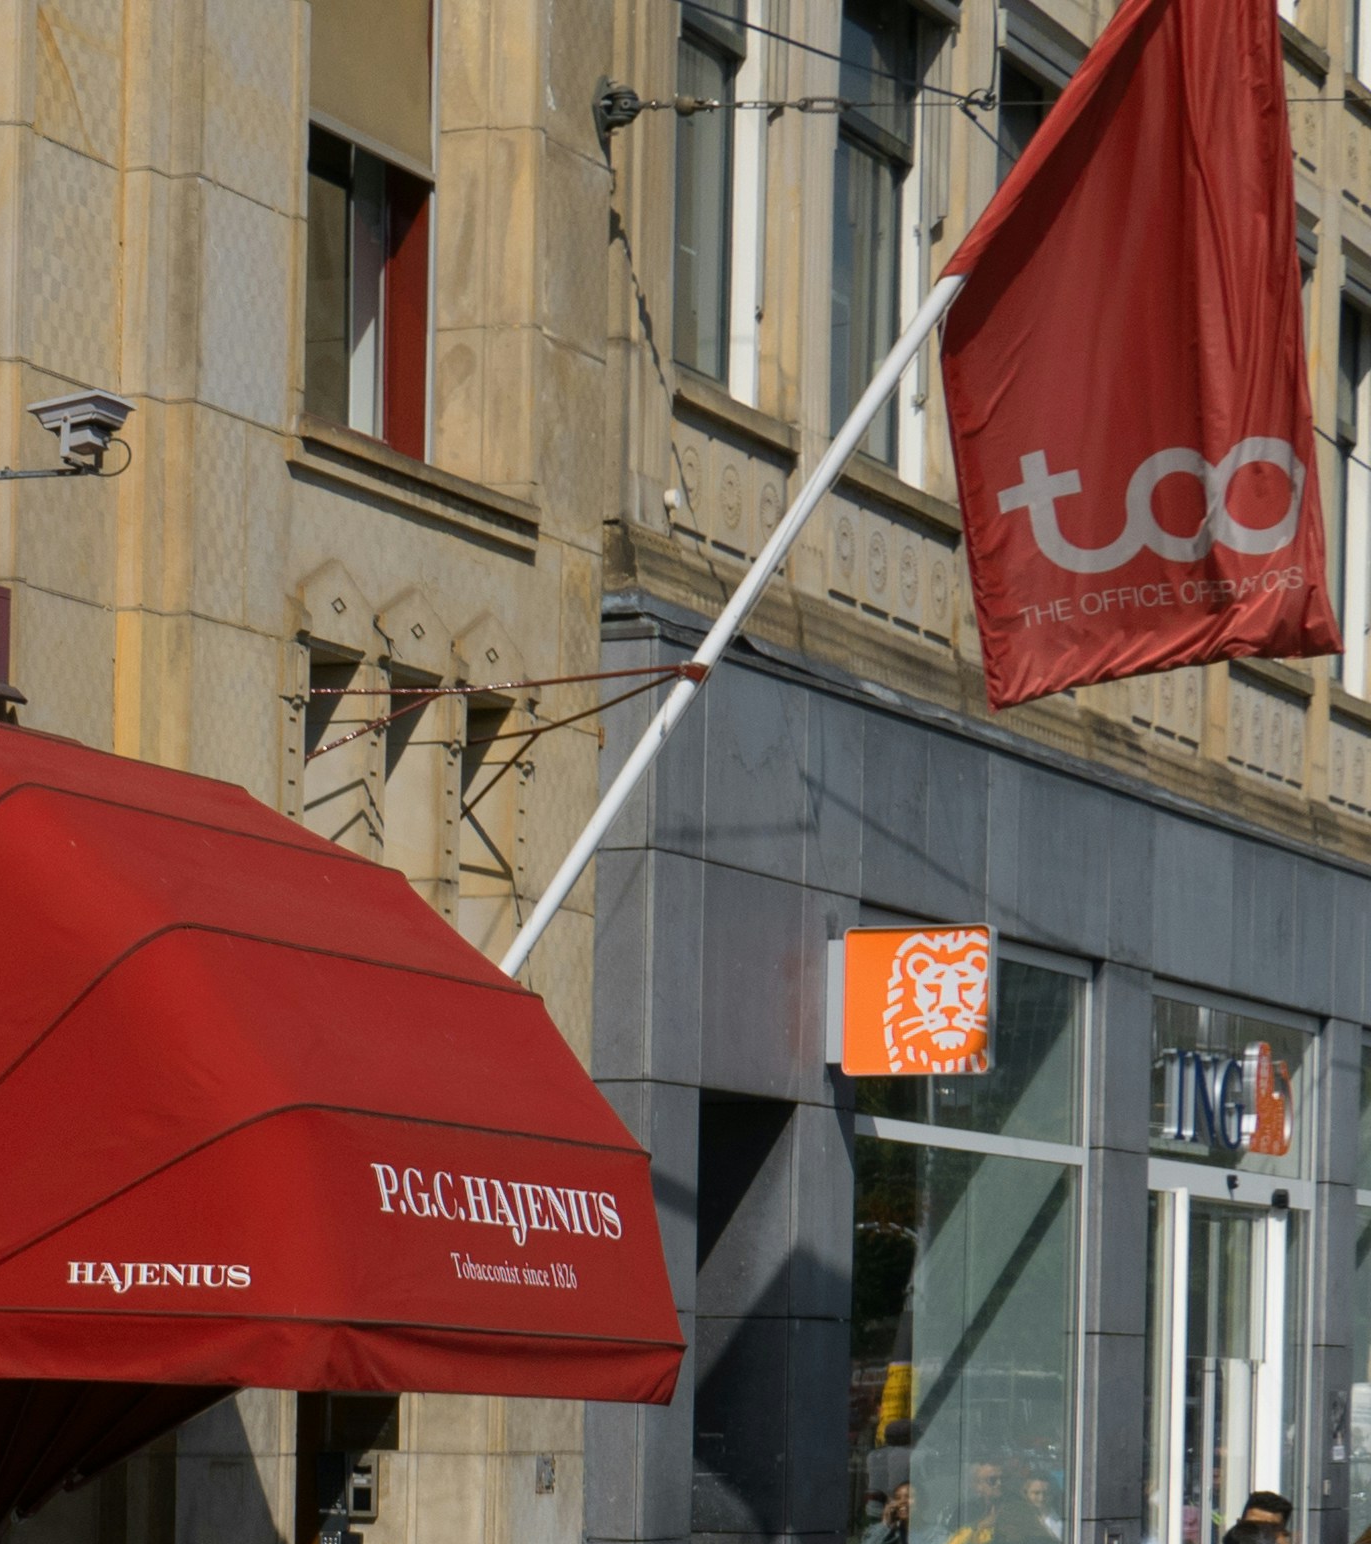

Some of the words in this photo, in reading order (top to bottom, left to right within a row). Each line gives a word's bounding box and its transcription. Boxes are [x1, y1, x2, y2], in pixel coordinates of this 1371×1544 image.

[1019, 597, 1074, 629] THE
[1079, 583, 1174, 617] OFFICE
[1163, 1048, 1244, 1151] ING
[67, 1261, 252, 1294] HAJENIUS
[450, 1252, 521, 1285] Tobacconist
[523, 1262, 550, 1287] since
[550, 1262, 578, 1290] 1826
